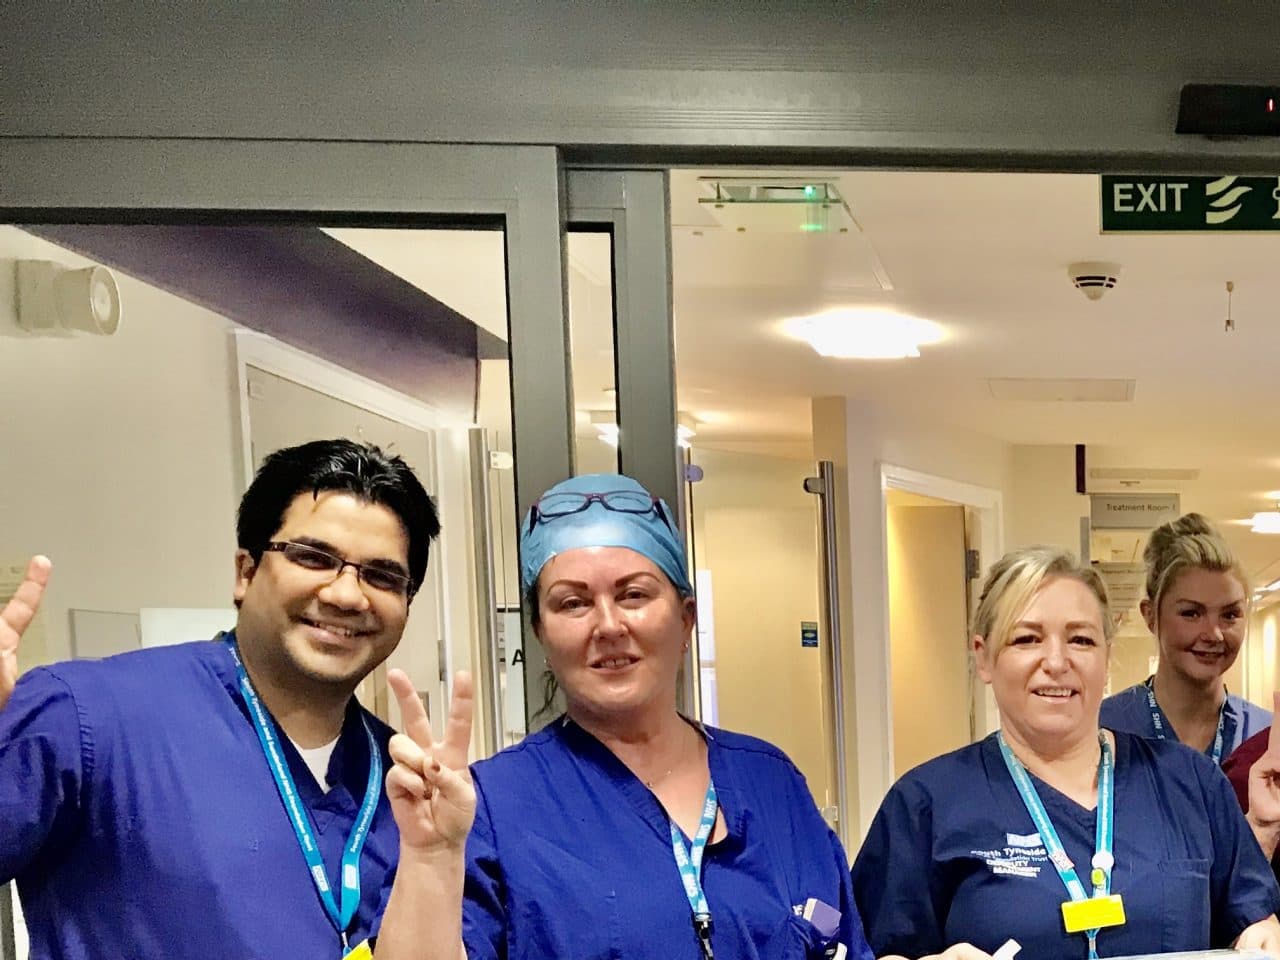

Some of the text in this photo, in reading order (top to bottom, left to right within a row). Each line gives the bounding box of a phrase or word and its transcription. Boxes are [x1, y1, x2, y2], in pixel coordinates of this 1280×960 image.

[1113, 183, 1189, 212] EXIT
[1106, 503, 1145, 511] Treatment
[1147, 503, 1170, 511] Room
[703, 799, 717, 818] NHS
